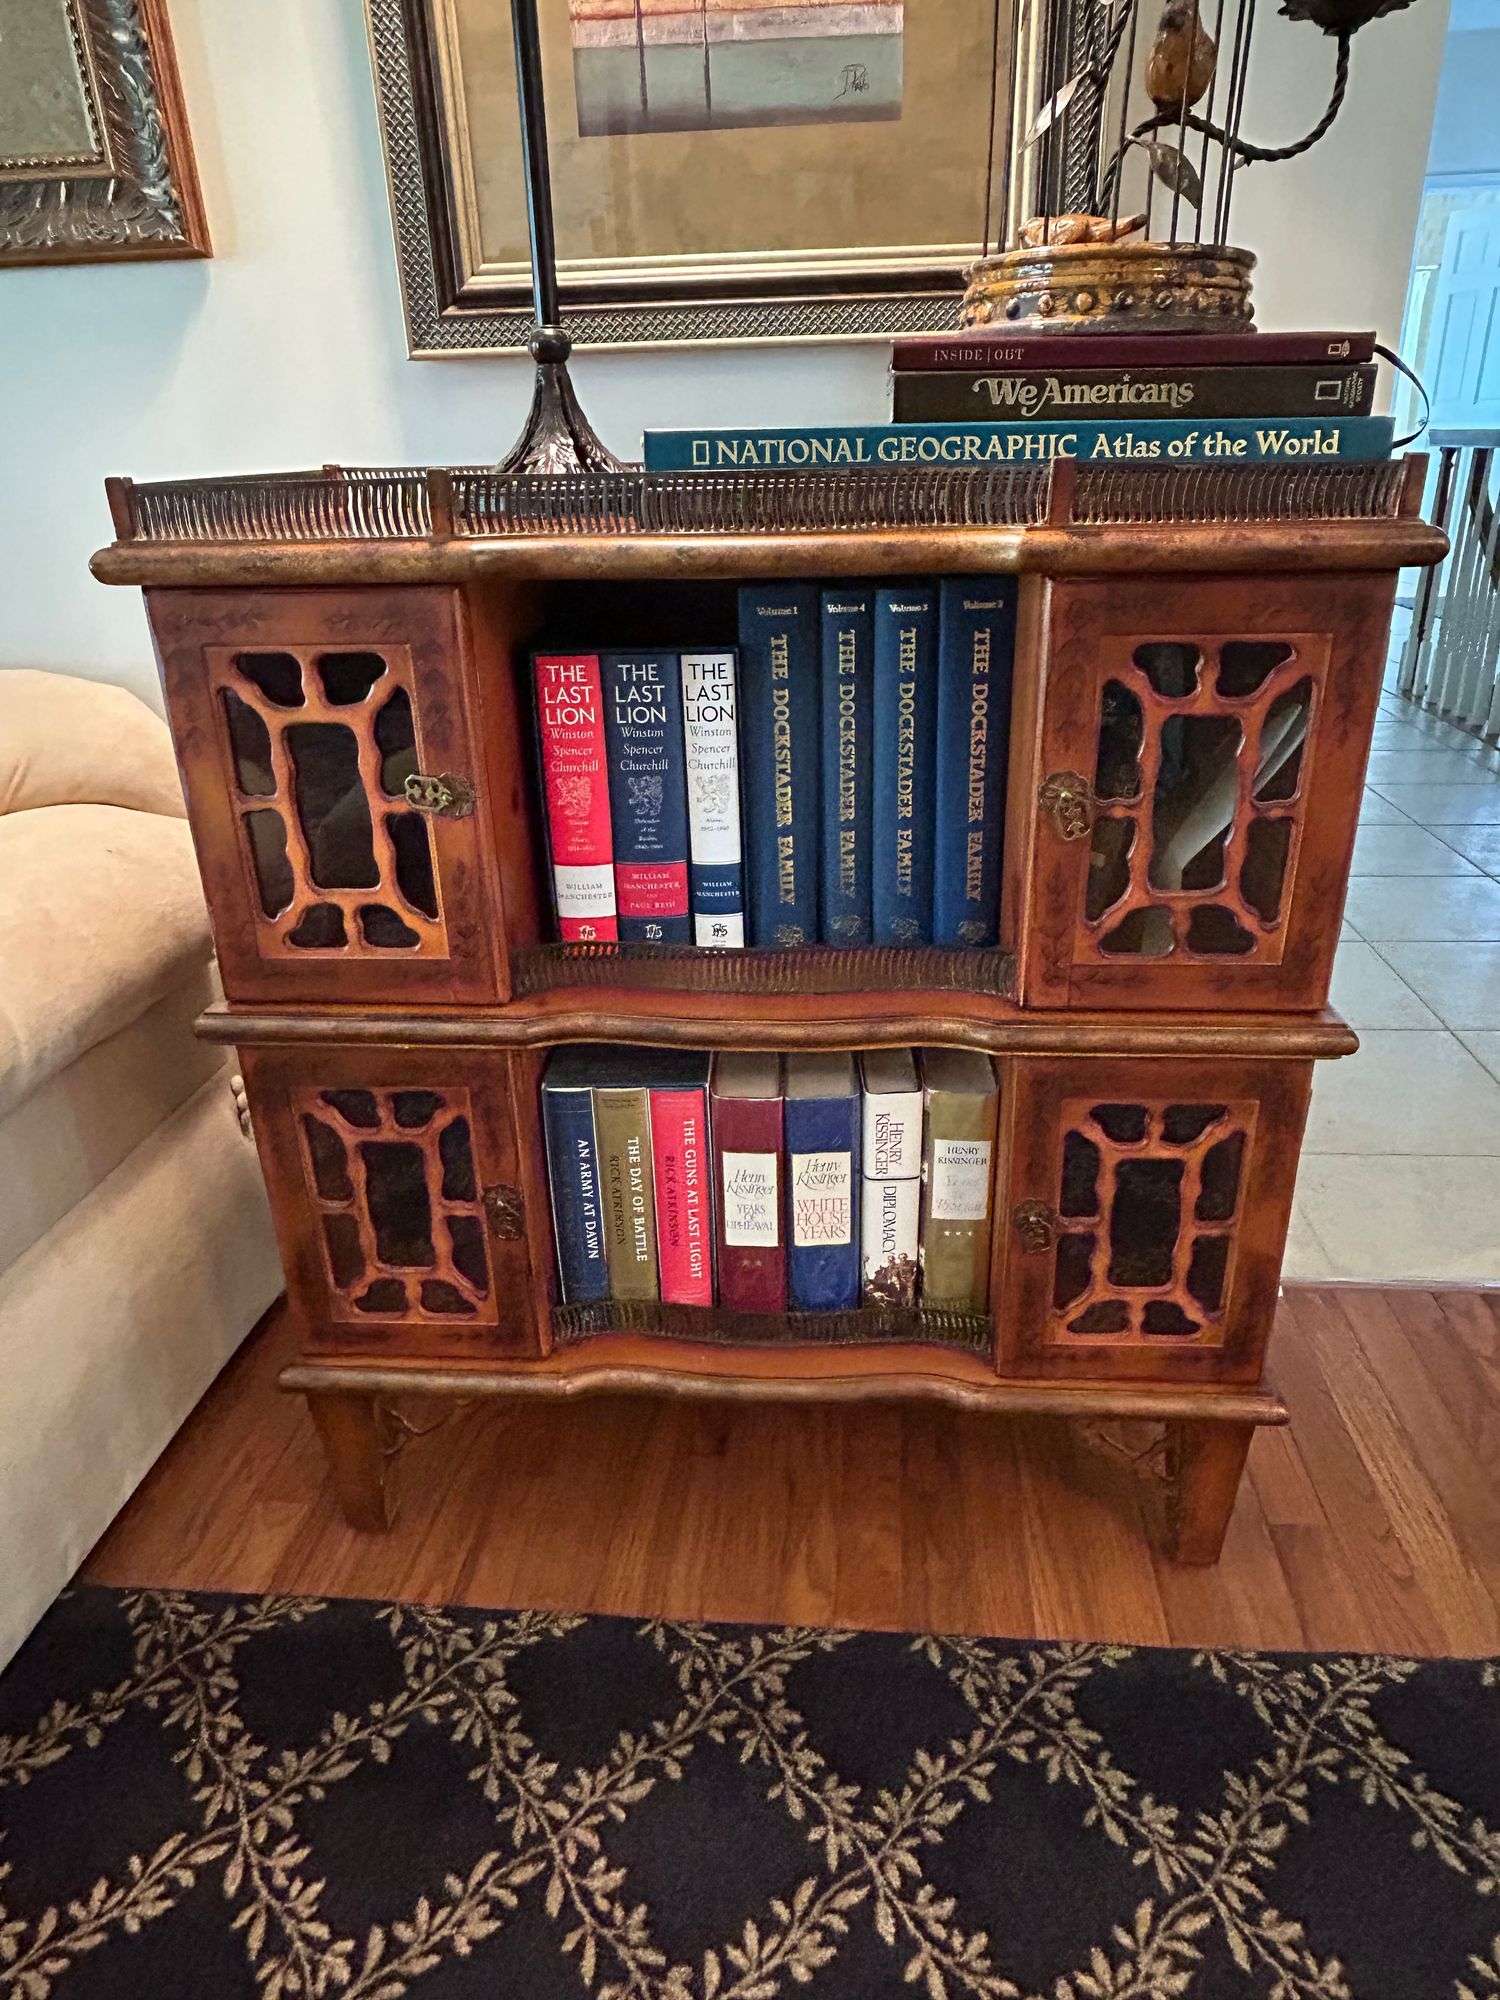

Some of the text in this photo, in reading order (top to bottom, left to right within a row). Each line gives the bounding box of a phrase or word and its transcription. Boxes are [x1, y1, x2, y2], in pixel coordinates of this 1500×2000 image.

[933, 347, 1025, 362] INSIDE OUT
[972, 373, 1194, 417] We Americans
[716, 429, 1341, 465] NATIONAL GEOGRAPHIC Atlas of the World
[838, 628, 856, 674] THE
[899, 627, 917, 673] THE
[545, 664, 588, 683] THE
[617, 664, 660, 682] THE
[688, 662, 728, 680] THE
[543, 685, 594, 705] LAST
[615, 685, 666, 703] LAST
[685, 683, 734, 702] LAST
[544, 706, 596, 726] LION
[616, 706, 667, 725] LION
[685, 705, 735, 722] LION
[549, 727, 595, 740] Winston
[621, 725, 664, 738] Winston
[689, 725, 732, 737] Winston
[552, 744, 593, 758] Spencer
[623, 743, 664, 756] Spencer
[691, 742, 731, 756] Spencer
[839, 683, 856, 822] DOCKSTADER
[897, 682, 915, 820] DOCKSTADER
[550, 759, 599, 773] Churchill
[620, 758, 669, 772] Churchill
[688, 758, 737, 771] Churchill
[770, 633, 795, 905] THE DOCKSTADER FAMILY
[966, 627, 991, 902] THE DOCKSTADER FAMILY
[875, 1112, 890, 1176] KISSINGER
[889, 1121, 905, 1166] HENRY
[946, 1146, 980, 1156] HENRY
[609, 1155, 622, 1185] RICK
[795, 1172, 848, 1191] Kissinger
[577, 1138, 600, 1259] AN ARMY AT DAWN
[627, 1136, 648, 1262] THE DAY OF BATTLE
[663, 1155, 680, 1247] RICK ATKINSON
[683, 1119, 703, 1279] THE GUNS AT LAST LIGHT
[796, 1197, 849, 1213] WHITE
[796, 1211, 850, 1227] HOUSE
[882, 1185, 897, 1255] DIPLOMACY
[800, 1225, 847, 1240] YEARS
